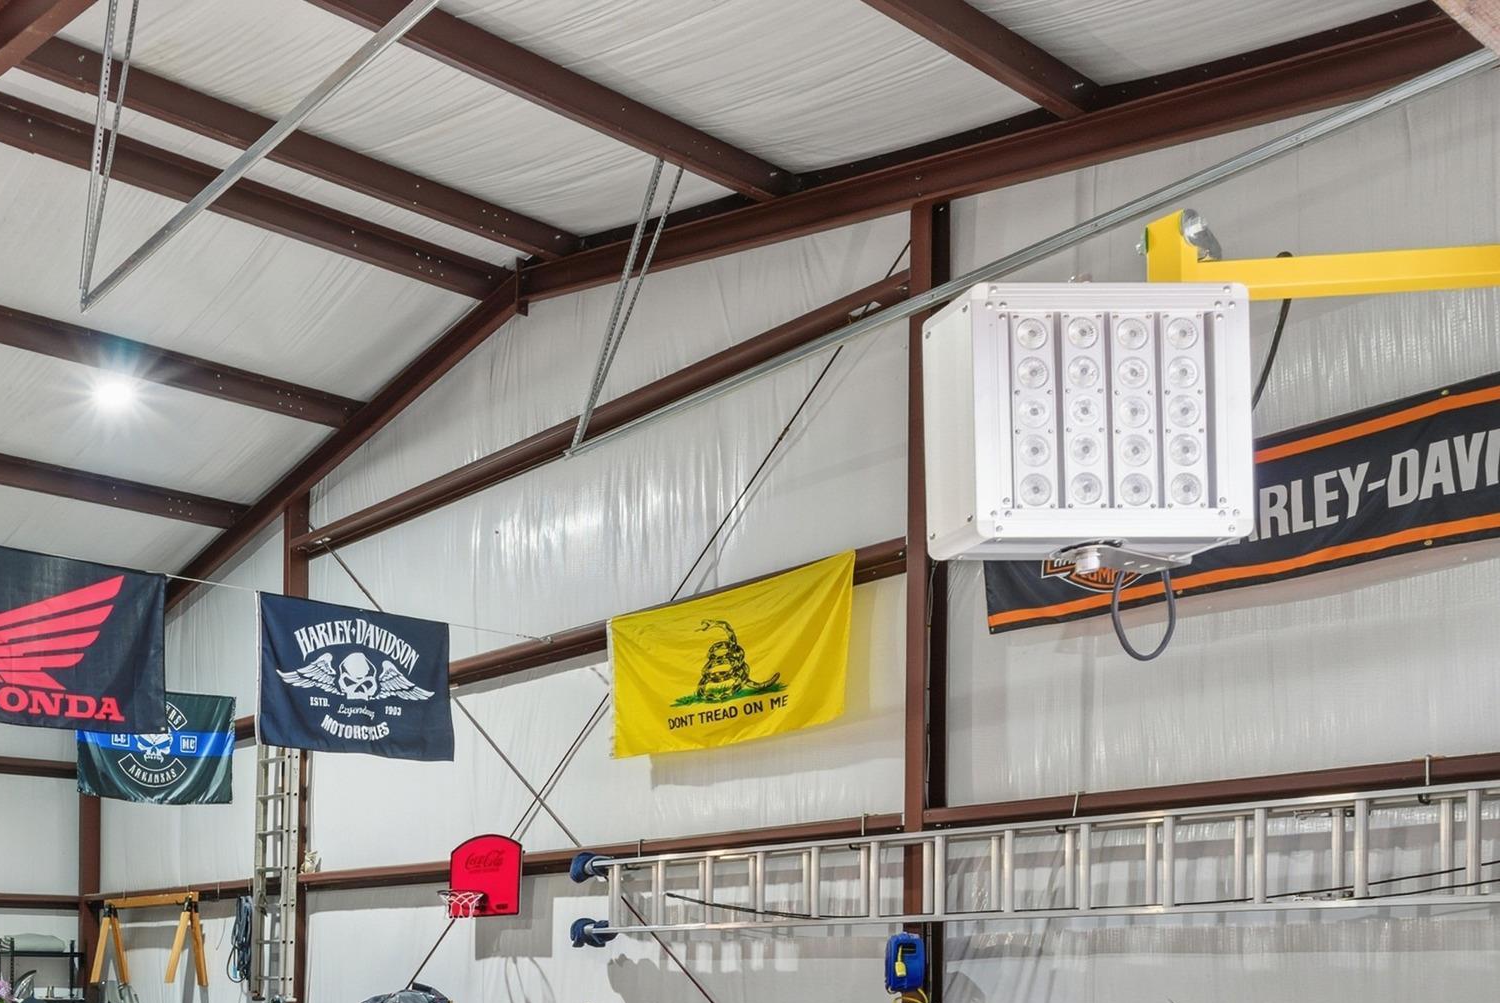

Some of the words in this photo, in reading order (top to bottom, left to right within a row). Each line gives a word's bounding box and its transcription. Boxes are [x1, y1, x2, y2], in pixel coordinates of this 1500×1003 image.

[293, 618, 419, 676] HARLEY-DAVIDSON
[320, 714, 390, 741] MOTORCYCLES
[668, 713, 694, 730] DONT
[697, 706, 738, 724] TREAD
[743, 698, 764, 716] ON
[770, 695, 789, 711] ME
[128, 764, 177, 784] ARKANSAS
